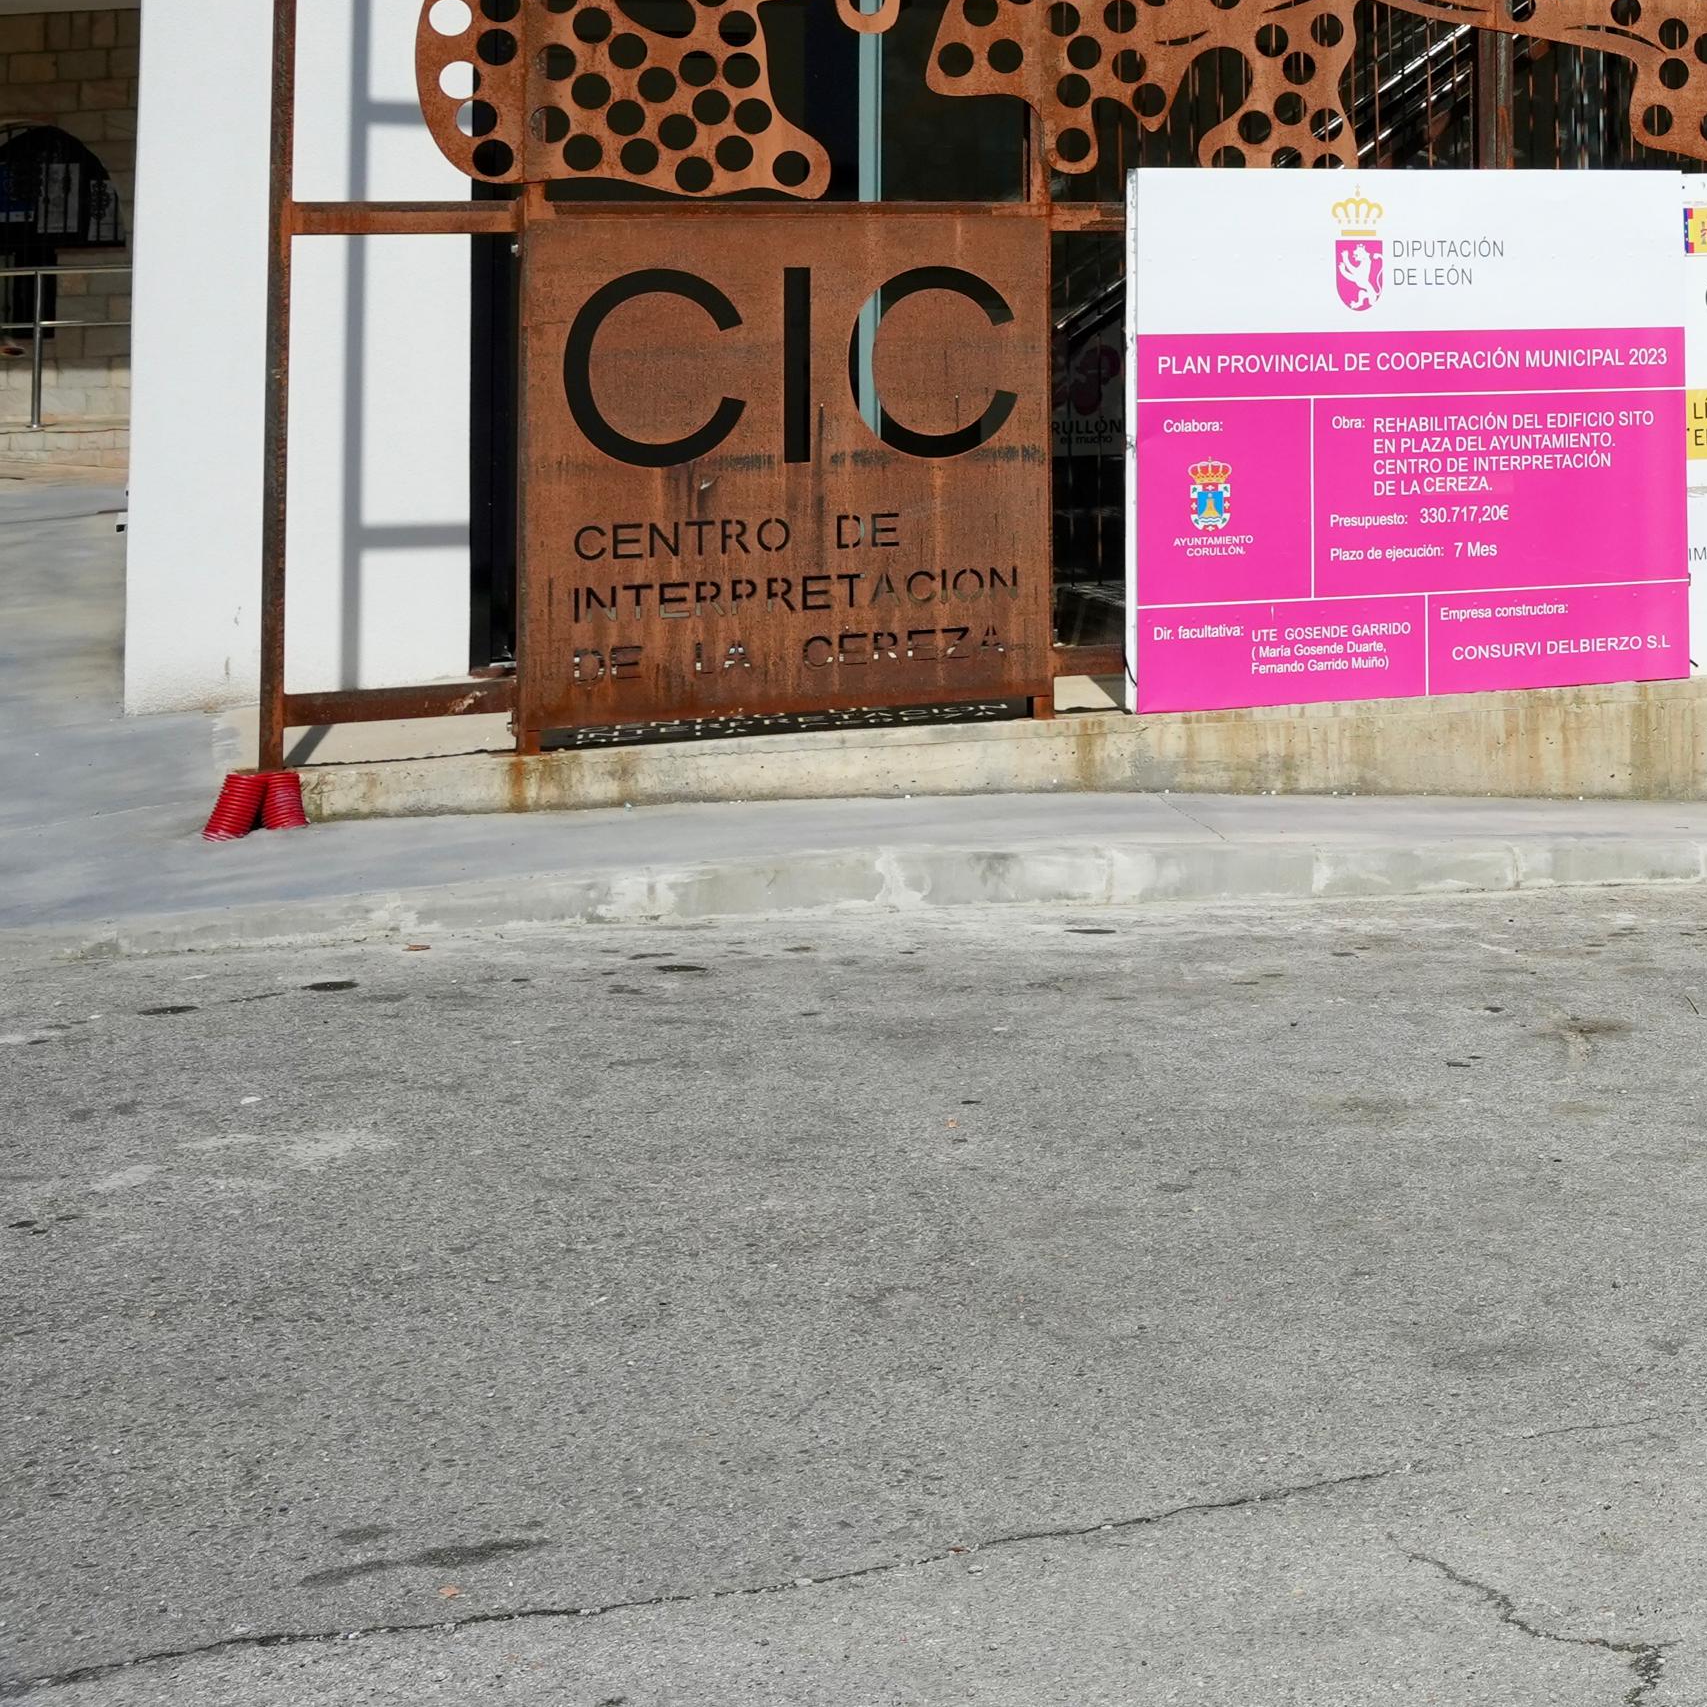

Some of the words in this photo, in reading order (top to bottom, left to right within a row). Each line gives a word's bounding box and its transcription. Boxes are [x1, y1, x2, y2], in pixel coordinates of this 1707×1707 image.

[1392, 237, 1504, 258] DIPUTACIÓN
[1393, 268, 1418, 286] DE
[1424, 264, 1473, 286] LEÓN
[563, 265, 1019, 468] CIC
[1158, 355, 1211, 375] PLAN
[1217, 353, 1339, 373] PROVINCIAL
[1344, 352, 1371, 371] DE
[1376, 348, 1520, 371] COOPERACIÓN
[1525, 348, 1625, 367] MUNICIPAL
[1628, 347, 1668, 366] 2023
[1163, 419, 1223, 433] Colabora:
[1331, 415, 1365, 429] Obra:
[1373, 413, 1508, 433] REHABILITACIÓN
[1512, 413, 1543, 429] DEL
[1546, 411, 1615, 428] EDIFICIO
[1618, 410, 1654, 426] SITO
[1373, 438, 1396, 454] EN
[1400, 437, 1453, 453] PLAZA
[1455, 435, 1487, 452] DEL
[1489, 432, 1616, 450] AYUNTAMIENTO.
[1373, 458, 1442, 475] CENTRO
[1446, 457, 1469, 473] DE
[1473, 452, 1611, 471] INTERPRETACIÓN
[1373, 480, 1396, 496] DE
[1400, 479, 1421, 495] LA
[1423, 476, 1493, 493] CEREZA.
[1330, 513, 1408, 528] Presupuesto:
[1419, 504, 1509, 524] 330.717,20€
[574, 517, 791, 561] CENTRO
[836, 512, 900, 550] DE
[1173, 535, 1254, 547] AYUNTAMIENTO
[1330, 547, 1364, 561] Plazo
[1366, 546, 1383, 560] de
[1385, 544, 1444, 562] ejecución:
[1454, 542, 1463, 558] 7
[1467, 541, 1498, 557] Mes
[574, 565, 1018, 624] INTERPRETACION
[1440, 607, 1492, 622] Empresa
[1494, 603, 1569, 617] constructora:
[1153, 626, 1174, 641] Dir.
[1178, 624, 1244, 639] facultativa:
[1251, 628, 1278, 642] UTE
[1284, 625, 1349, 640] GOSENDE
[1351, 621, 1412, 637] GARRIDO
[573, 645, 643, 685] DE
[695, 640, 751, 675] LA
[802, 624, 1005, 671] CEREZA
[1259, 645, 1291, 658] María
[1293, 642, 1344, 656] Gosende
[1346, 641, 1387, 653] Duarte,
[1452, 642, 1541, 661] CONSURVI
[1546, 636, 1643, 654] DELBIERZO
[1646, 634, 1671, 649] S.L
[1251, 660, 1305, 674] Fernando
[1307, 658, 1349, 672] Garrido
[1351, 655, 1390, 670] Muiño)
